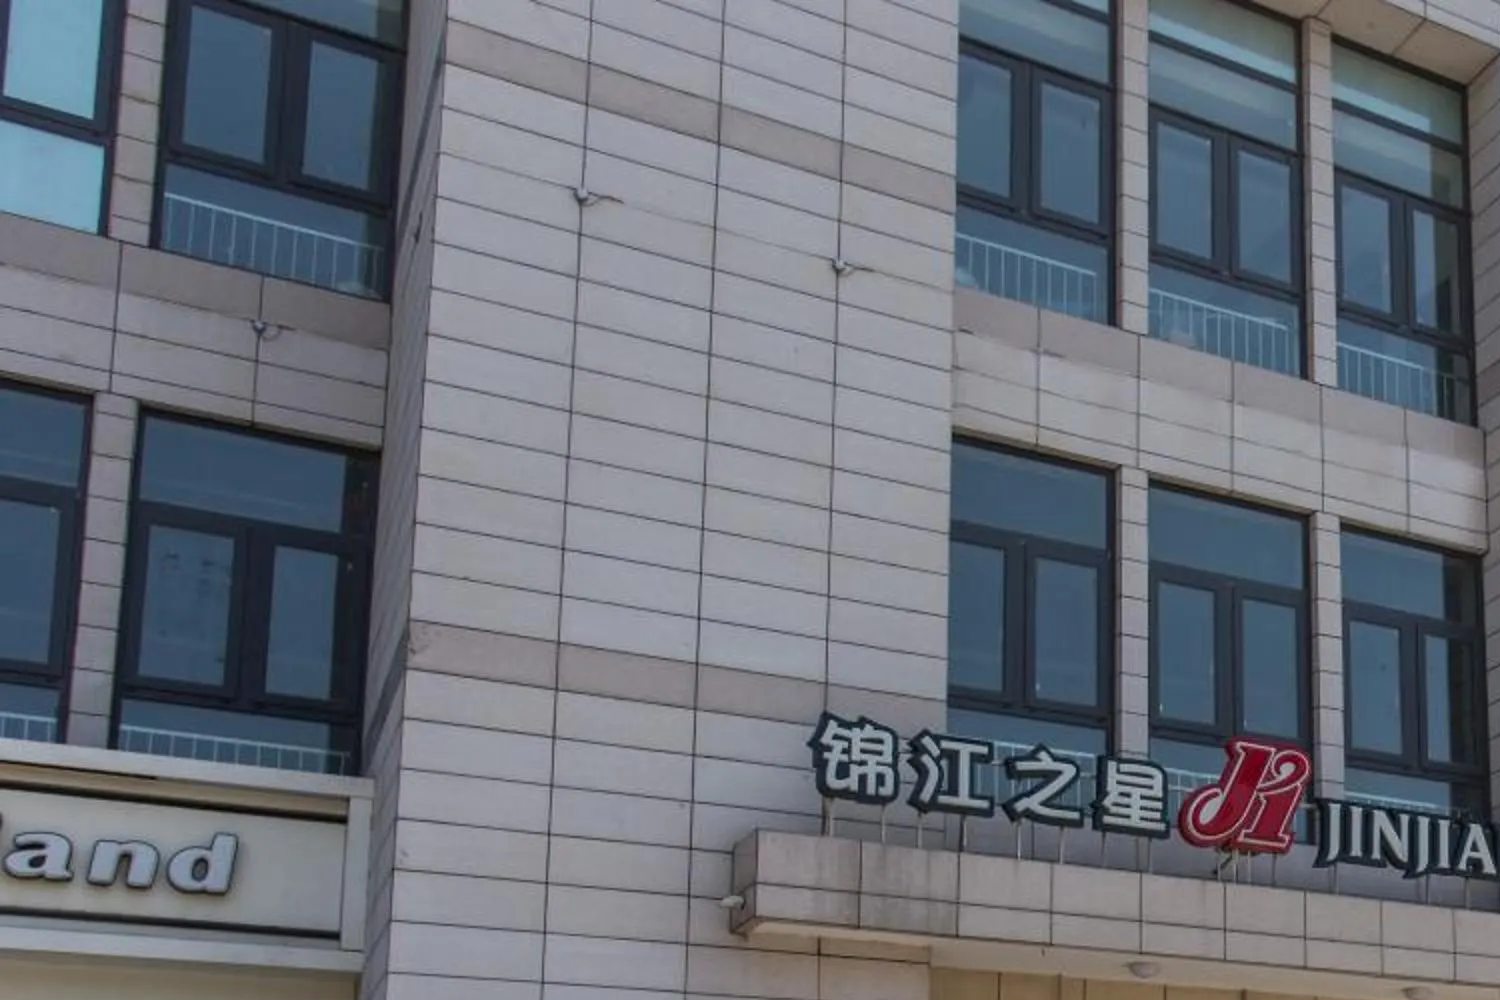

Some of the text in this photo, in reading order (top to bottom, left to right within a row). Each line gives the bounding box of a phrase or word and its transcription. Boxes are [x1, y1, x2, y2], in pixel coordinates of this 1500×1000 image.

[818, 714, 1168, 832] 锦江之星
[0, 812, 239, 896] and
